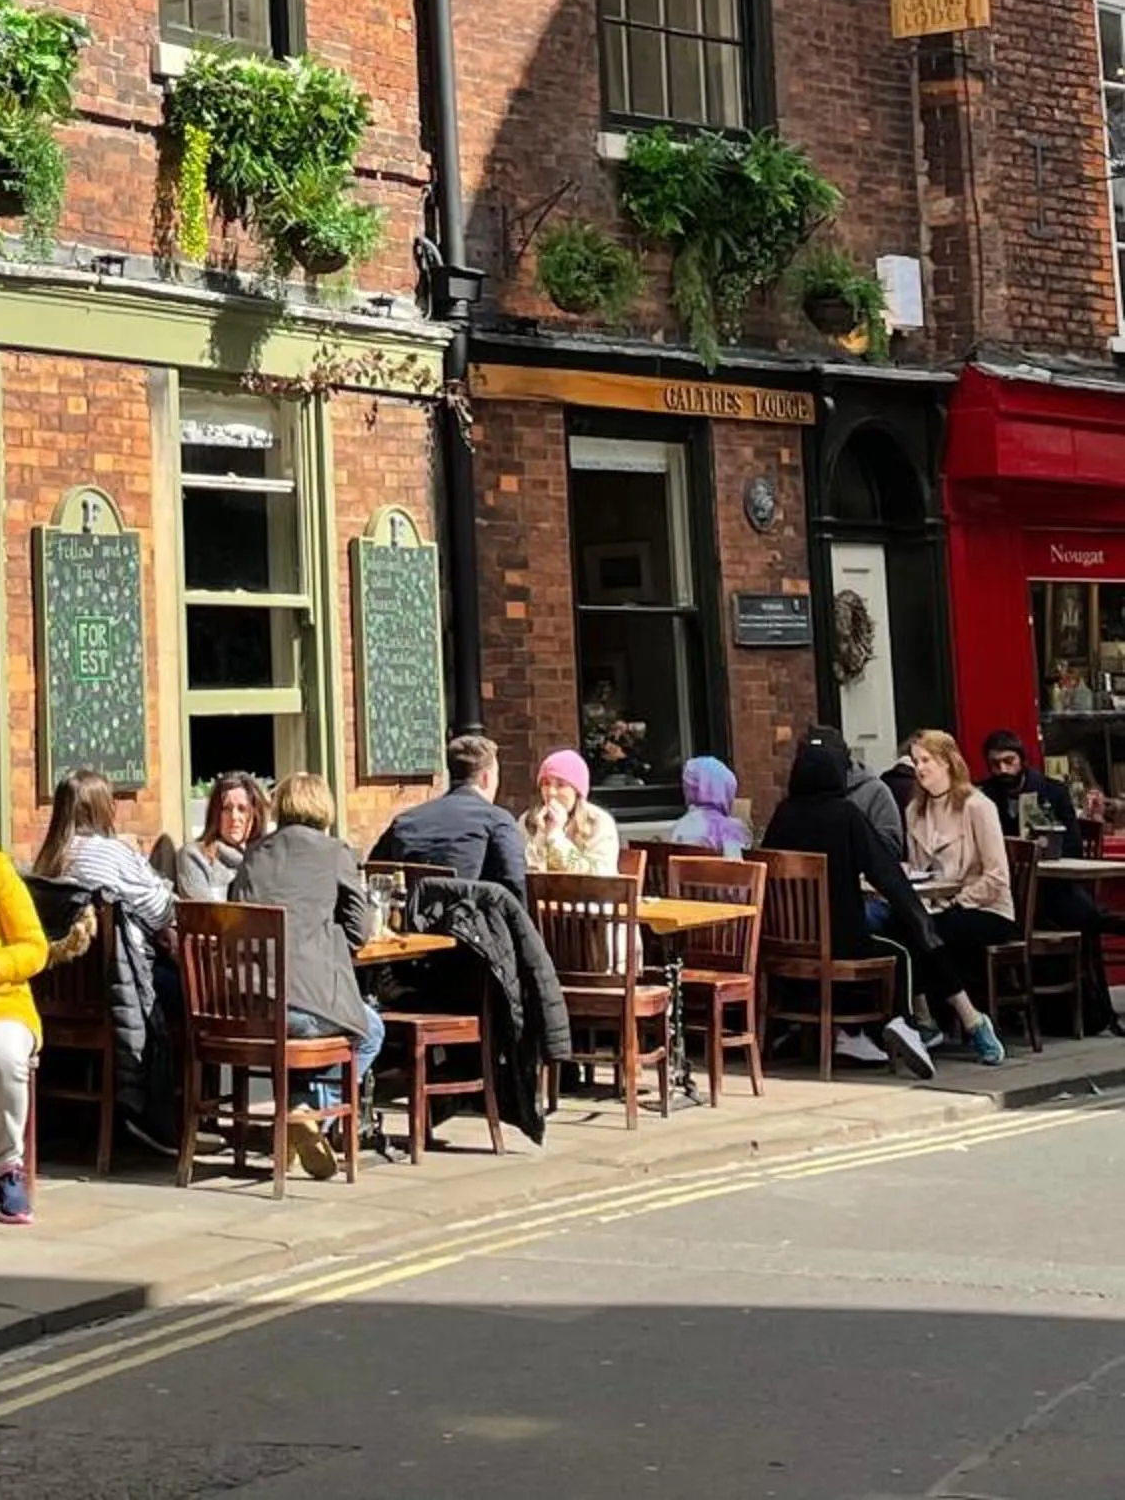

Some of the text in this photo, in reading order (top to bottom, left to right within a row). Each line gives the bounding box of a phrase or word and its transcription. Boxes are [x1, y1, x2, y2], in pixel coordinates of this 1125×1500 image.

[754, 391, 811, 420] LODGE
[57, 538, 94, 560] Follow
[1050, 544, 1105, 567] Nougat
[78, 623, 108, 647] FOR
[79, 650, 108, 675] EST
